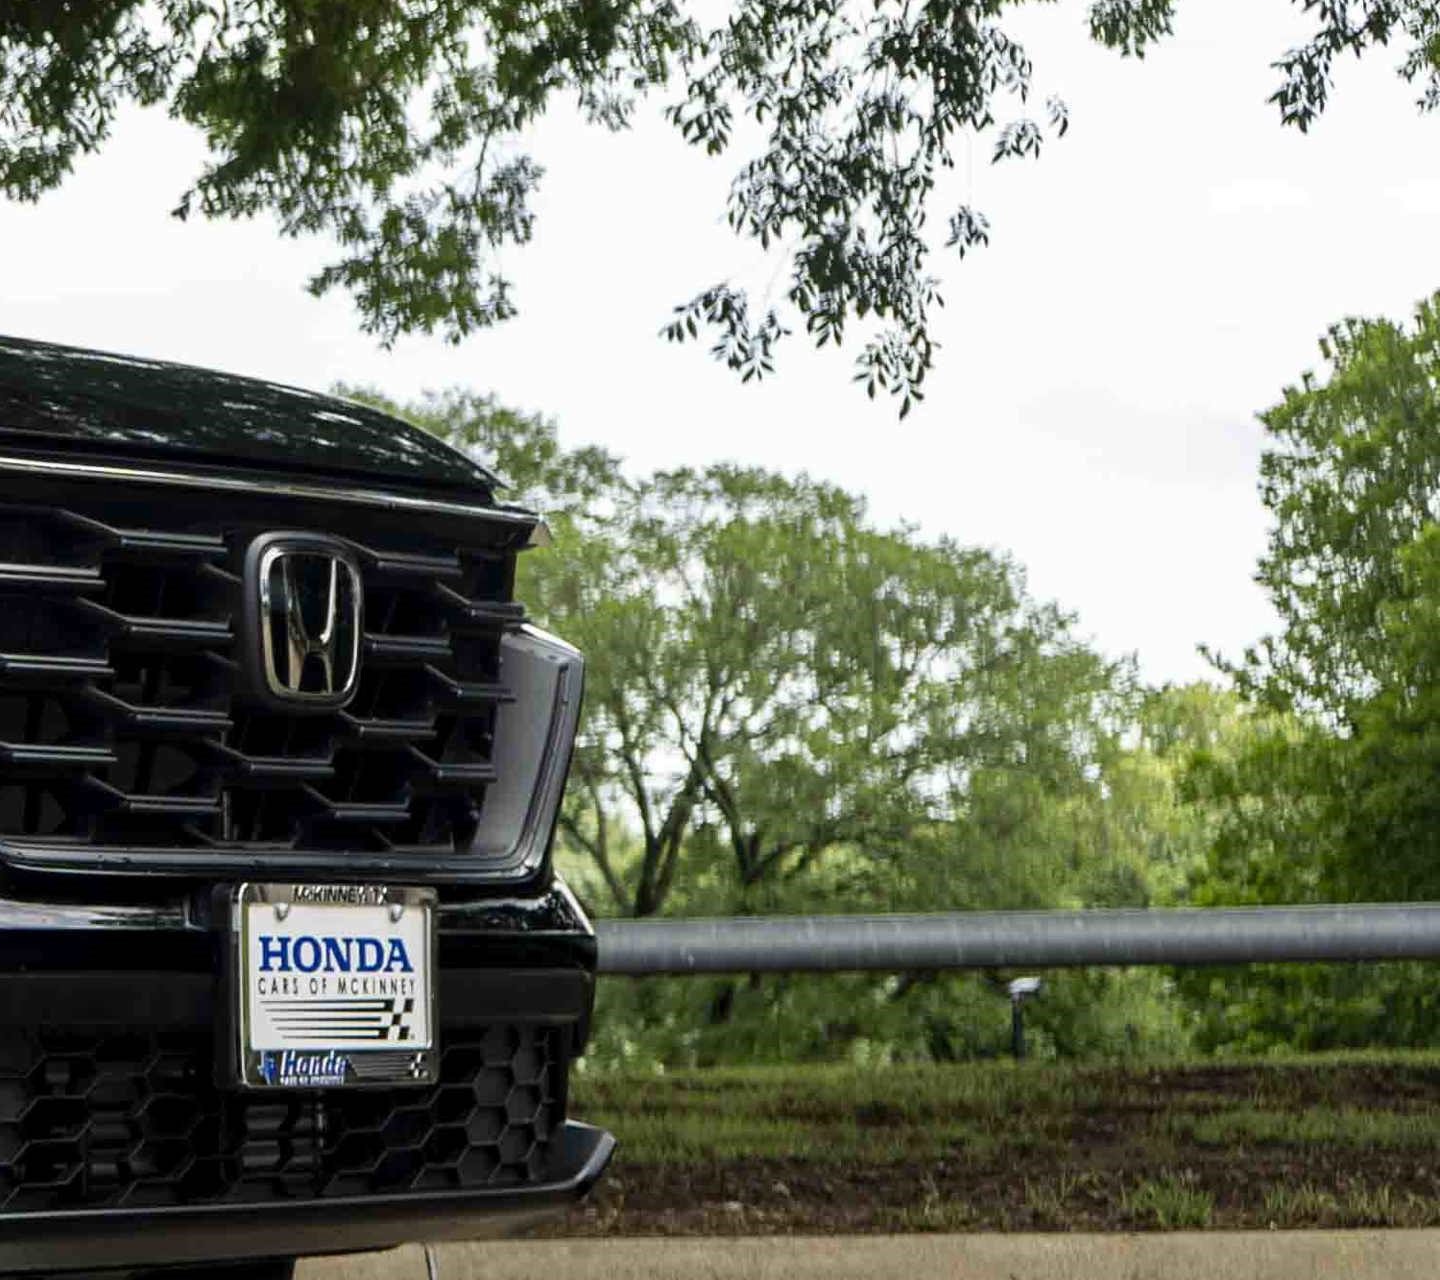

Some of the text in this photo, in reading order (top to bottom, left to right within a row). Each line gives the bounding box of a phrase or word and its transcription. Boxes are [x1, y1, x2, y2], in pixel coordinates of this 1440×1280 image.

[258, 936, 414, 973] HONDA
[258, 977, 416, 996] CARS OF MCKINNEY
